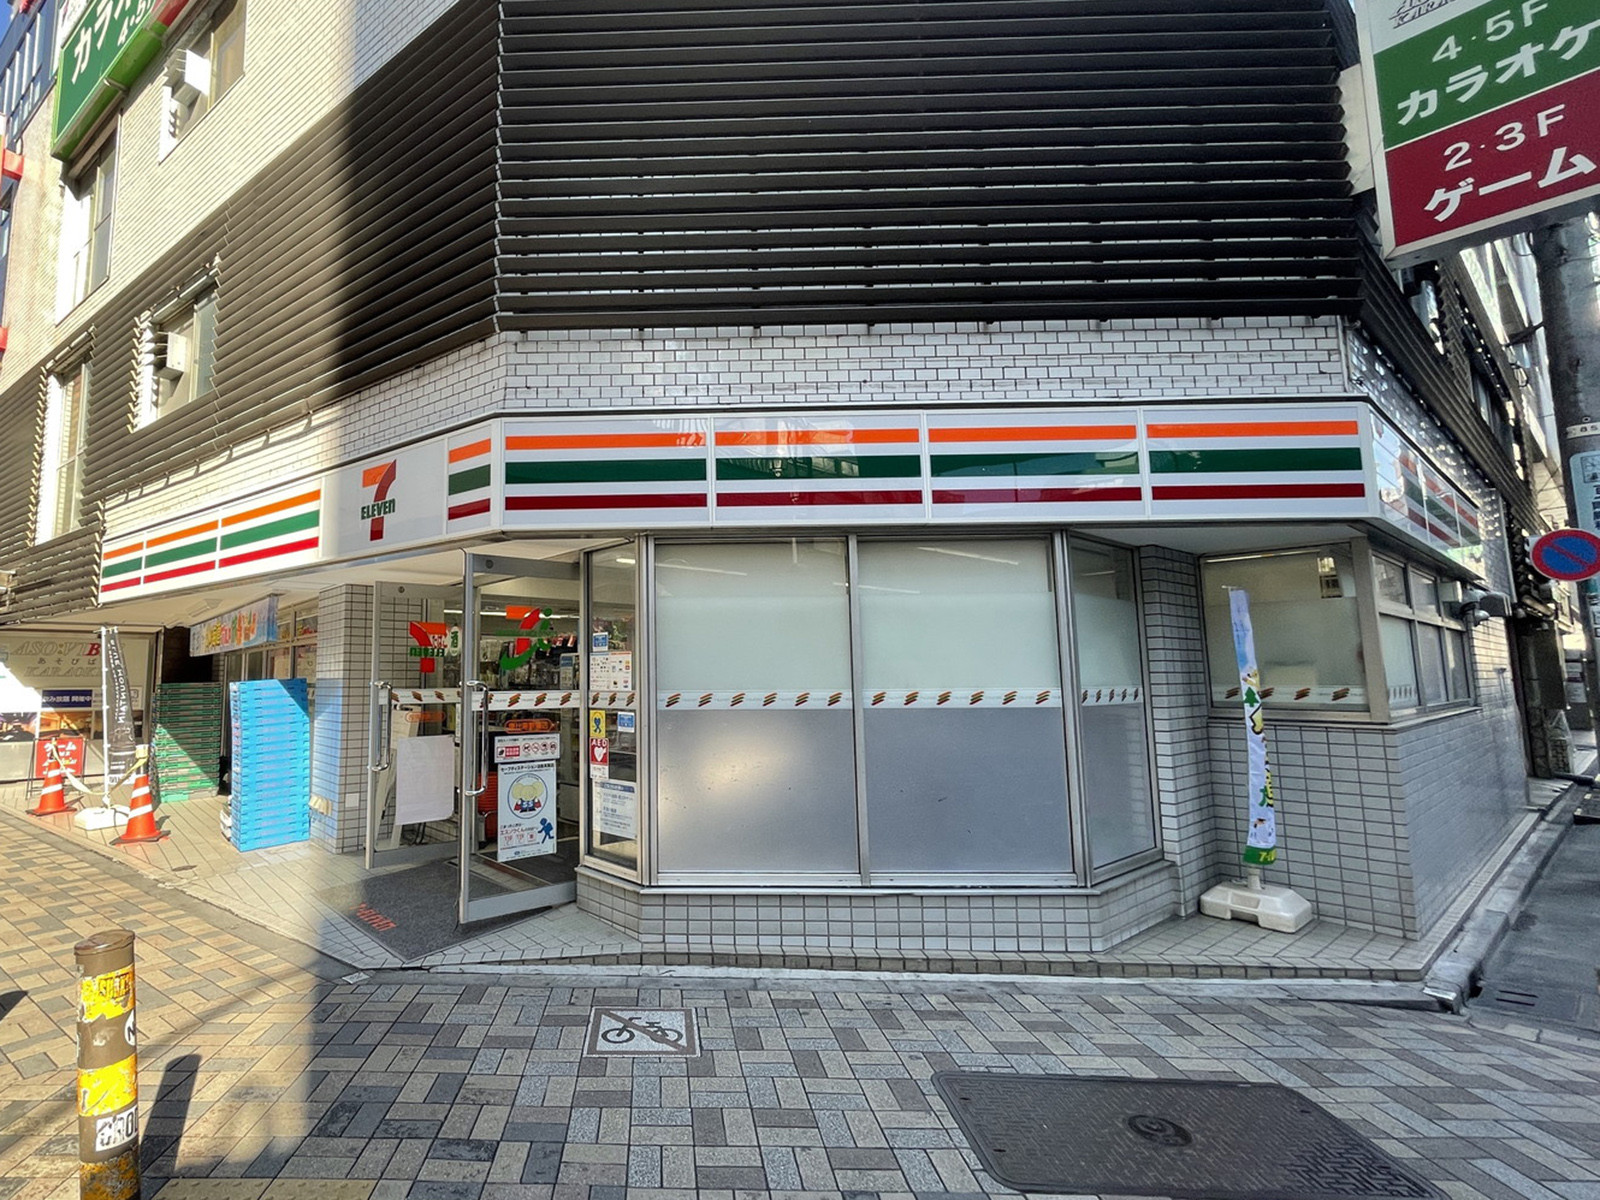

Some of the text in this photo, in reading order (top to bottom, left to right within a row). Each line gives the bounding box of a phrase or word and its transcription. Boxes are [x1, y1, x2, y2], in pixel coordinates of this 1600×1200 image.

[1397, 20, 1600, 126] カラオケ
[1424, 147, 1597, 222] ゲーム
[591, 739, 608, 748] AED
